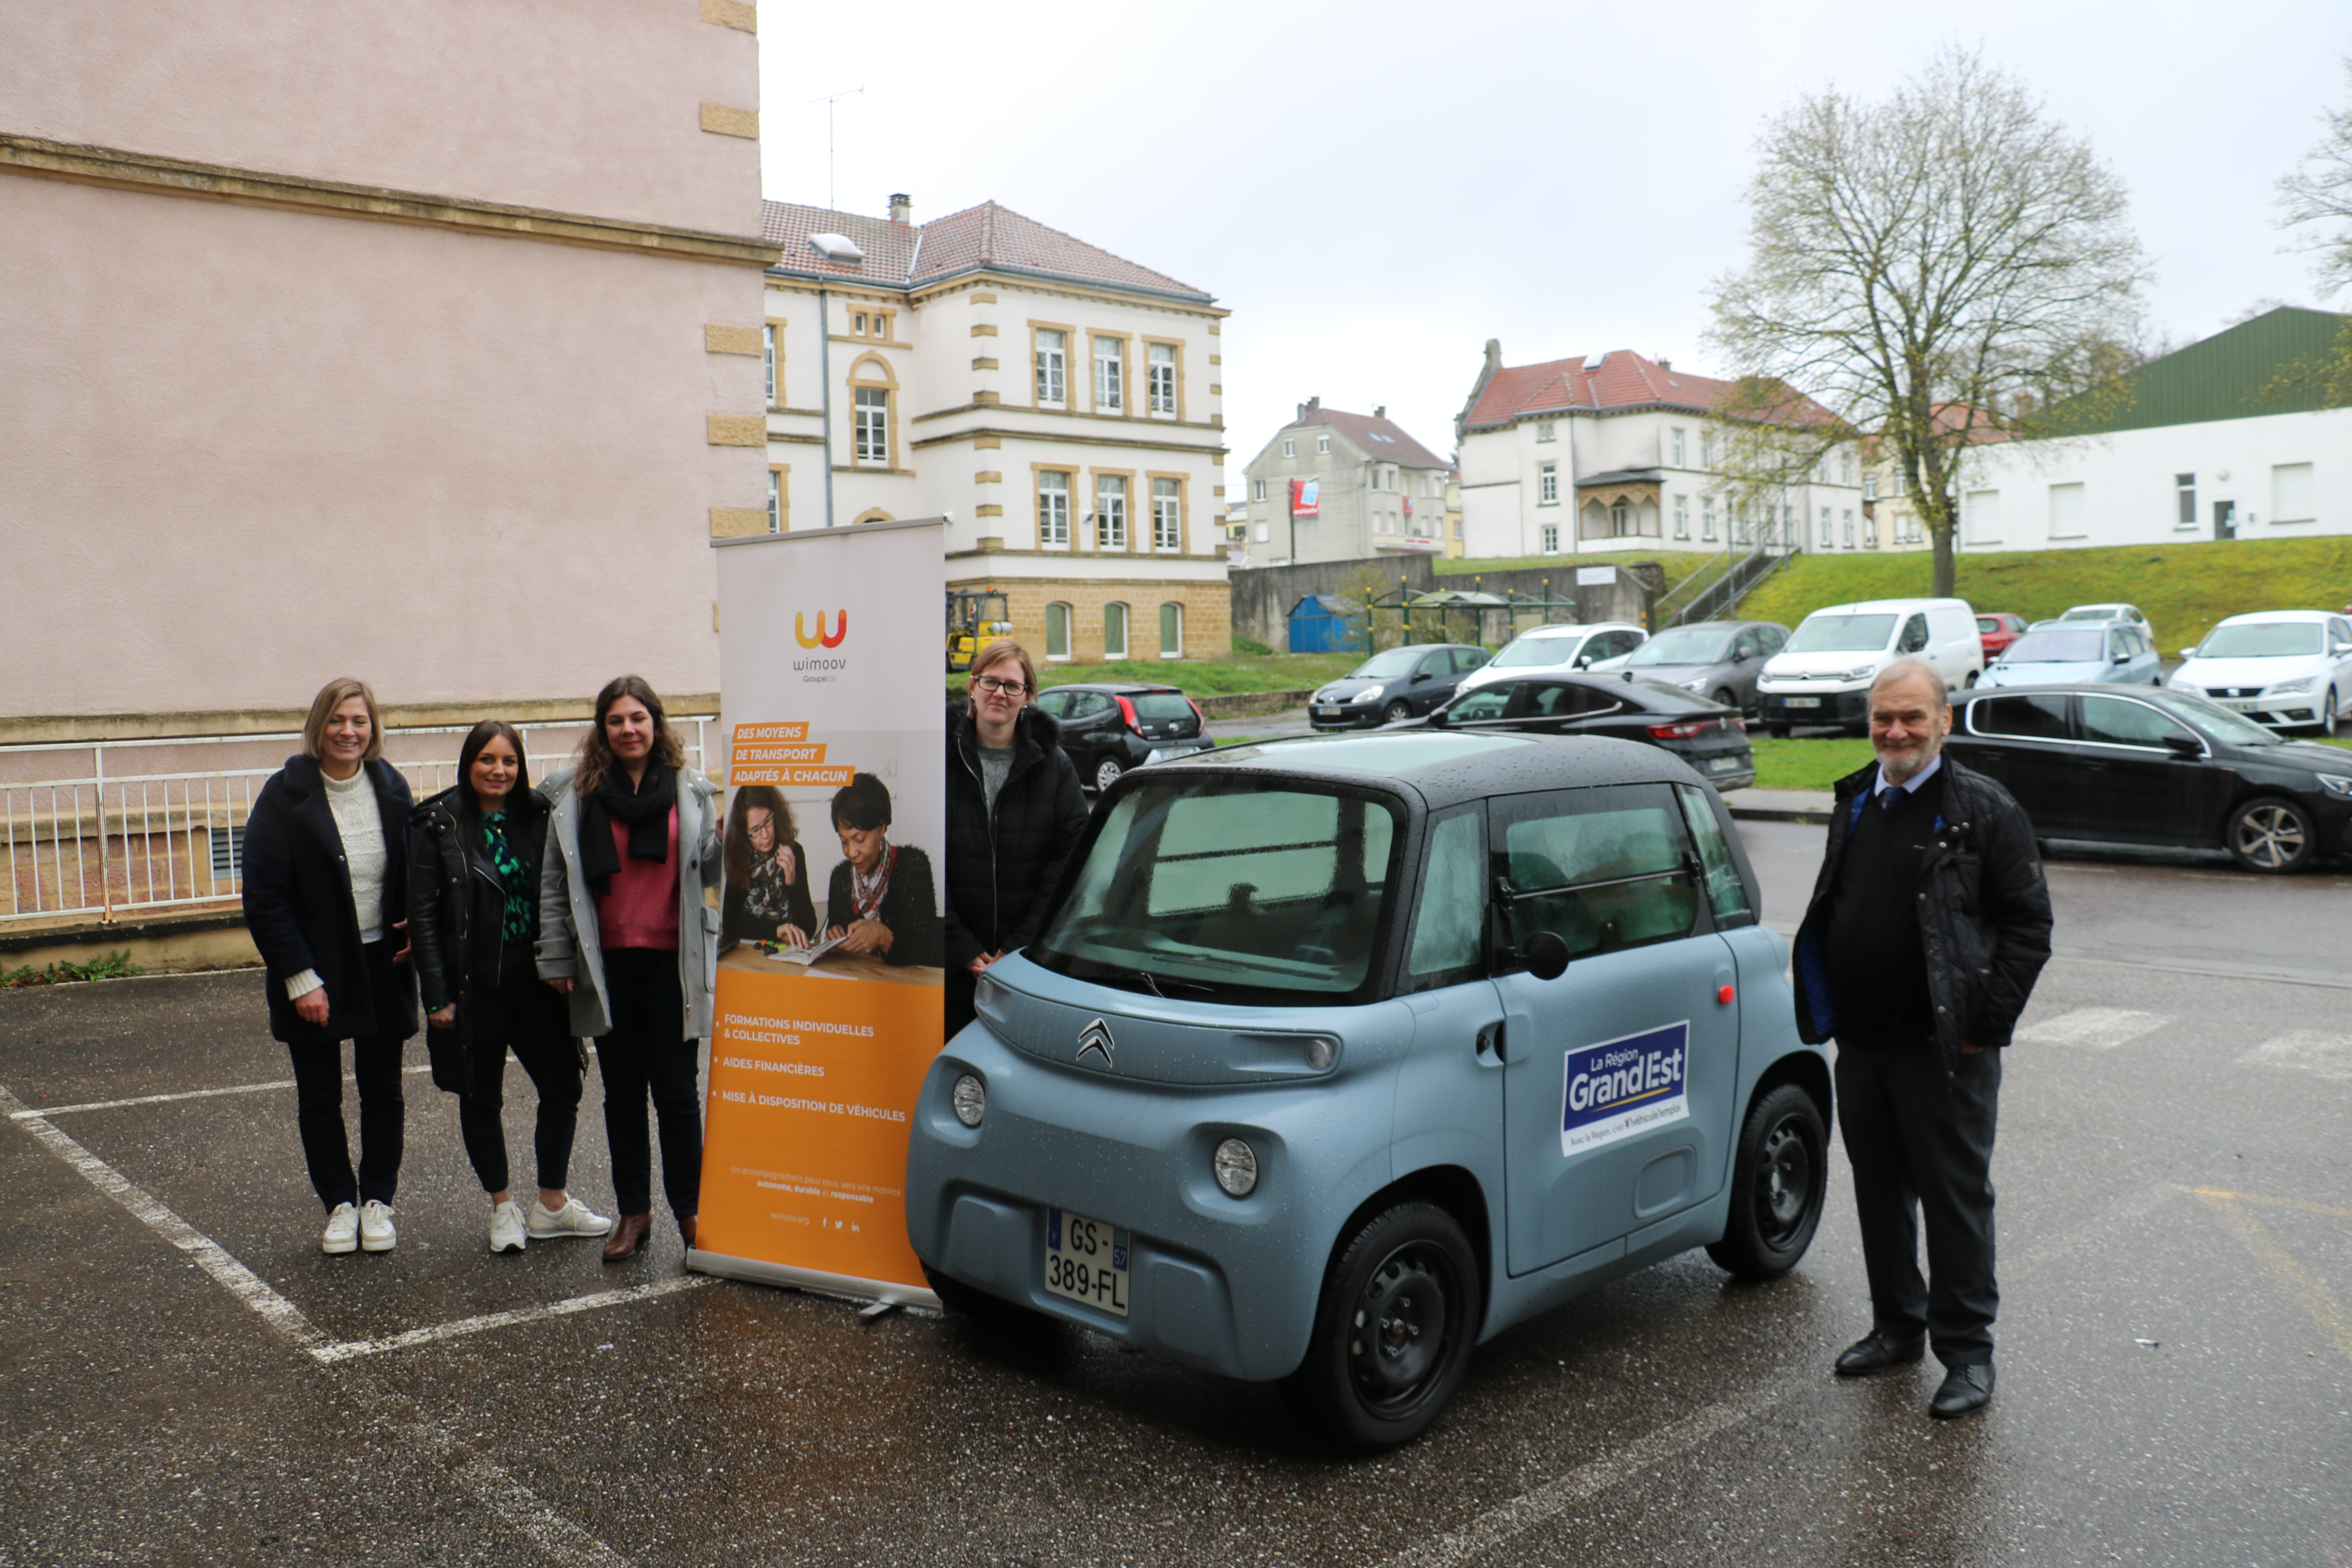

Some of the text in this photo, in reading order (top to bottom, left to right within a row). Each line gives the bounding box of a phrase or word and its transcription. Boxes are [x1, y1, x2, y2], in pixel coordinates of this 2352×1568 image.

[793, 657, 846, 671] wimoov
[737, 726, 802, 739] DES MOYENS
[735, 748, 818, 760] DE TRANSPORT
[734, 768, 848, 782] ADAPTÉS À CHACUN
[725, 1014, 875, 1037] FORMATIONS INDIVIDUELLES
[724, 1028, 800, 1045] & COLLECTIVES
[723, 1057, 825, 1077] AIDES FINANCIÈRES
[1591, 1048, 1639, 1072] La Région
[722, 1090, 906, 1122] MISE À DISPOSITION DE VÉHICULES
[1571, 1137, 1585, 1147] Avec
[731, 1165, 741, 1174] Un
[742, 1168, 804, 1183] accompagnement
[805, 1176, 820, 1185] pour
[841, 1182, 856, 1190] vers
[857, 1184, 871, 1192] une
[873, 1185, 901, 1197] mobilité
[757, 1180, 874, 1203] autonome, durable et responsable
[770, 1211, 810, 1226] wimoov.org
[1052, 1233, 1057, 1242] F
[1114, 1248, 1127, 1267] 57
[1049, 1254, 1125, 1310] 389-FL
